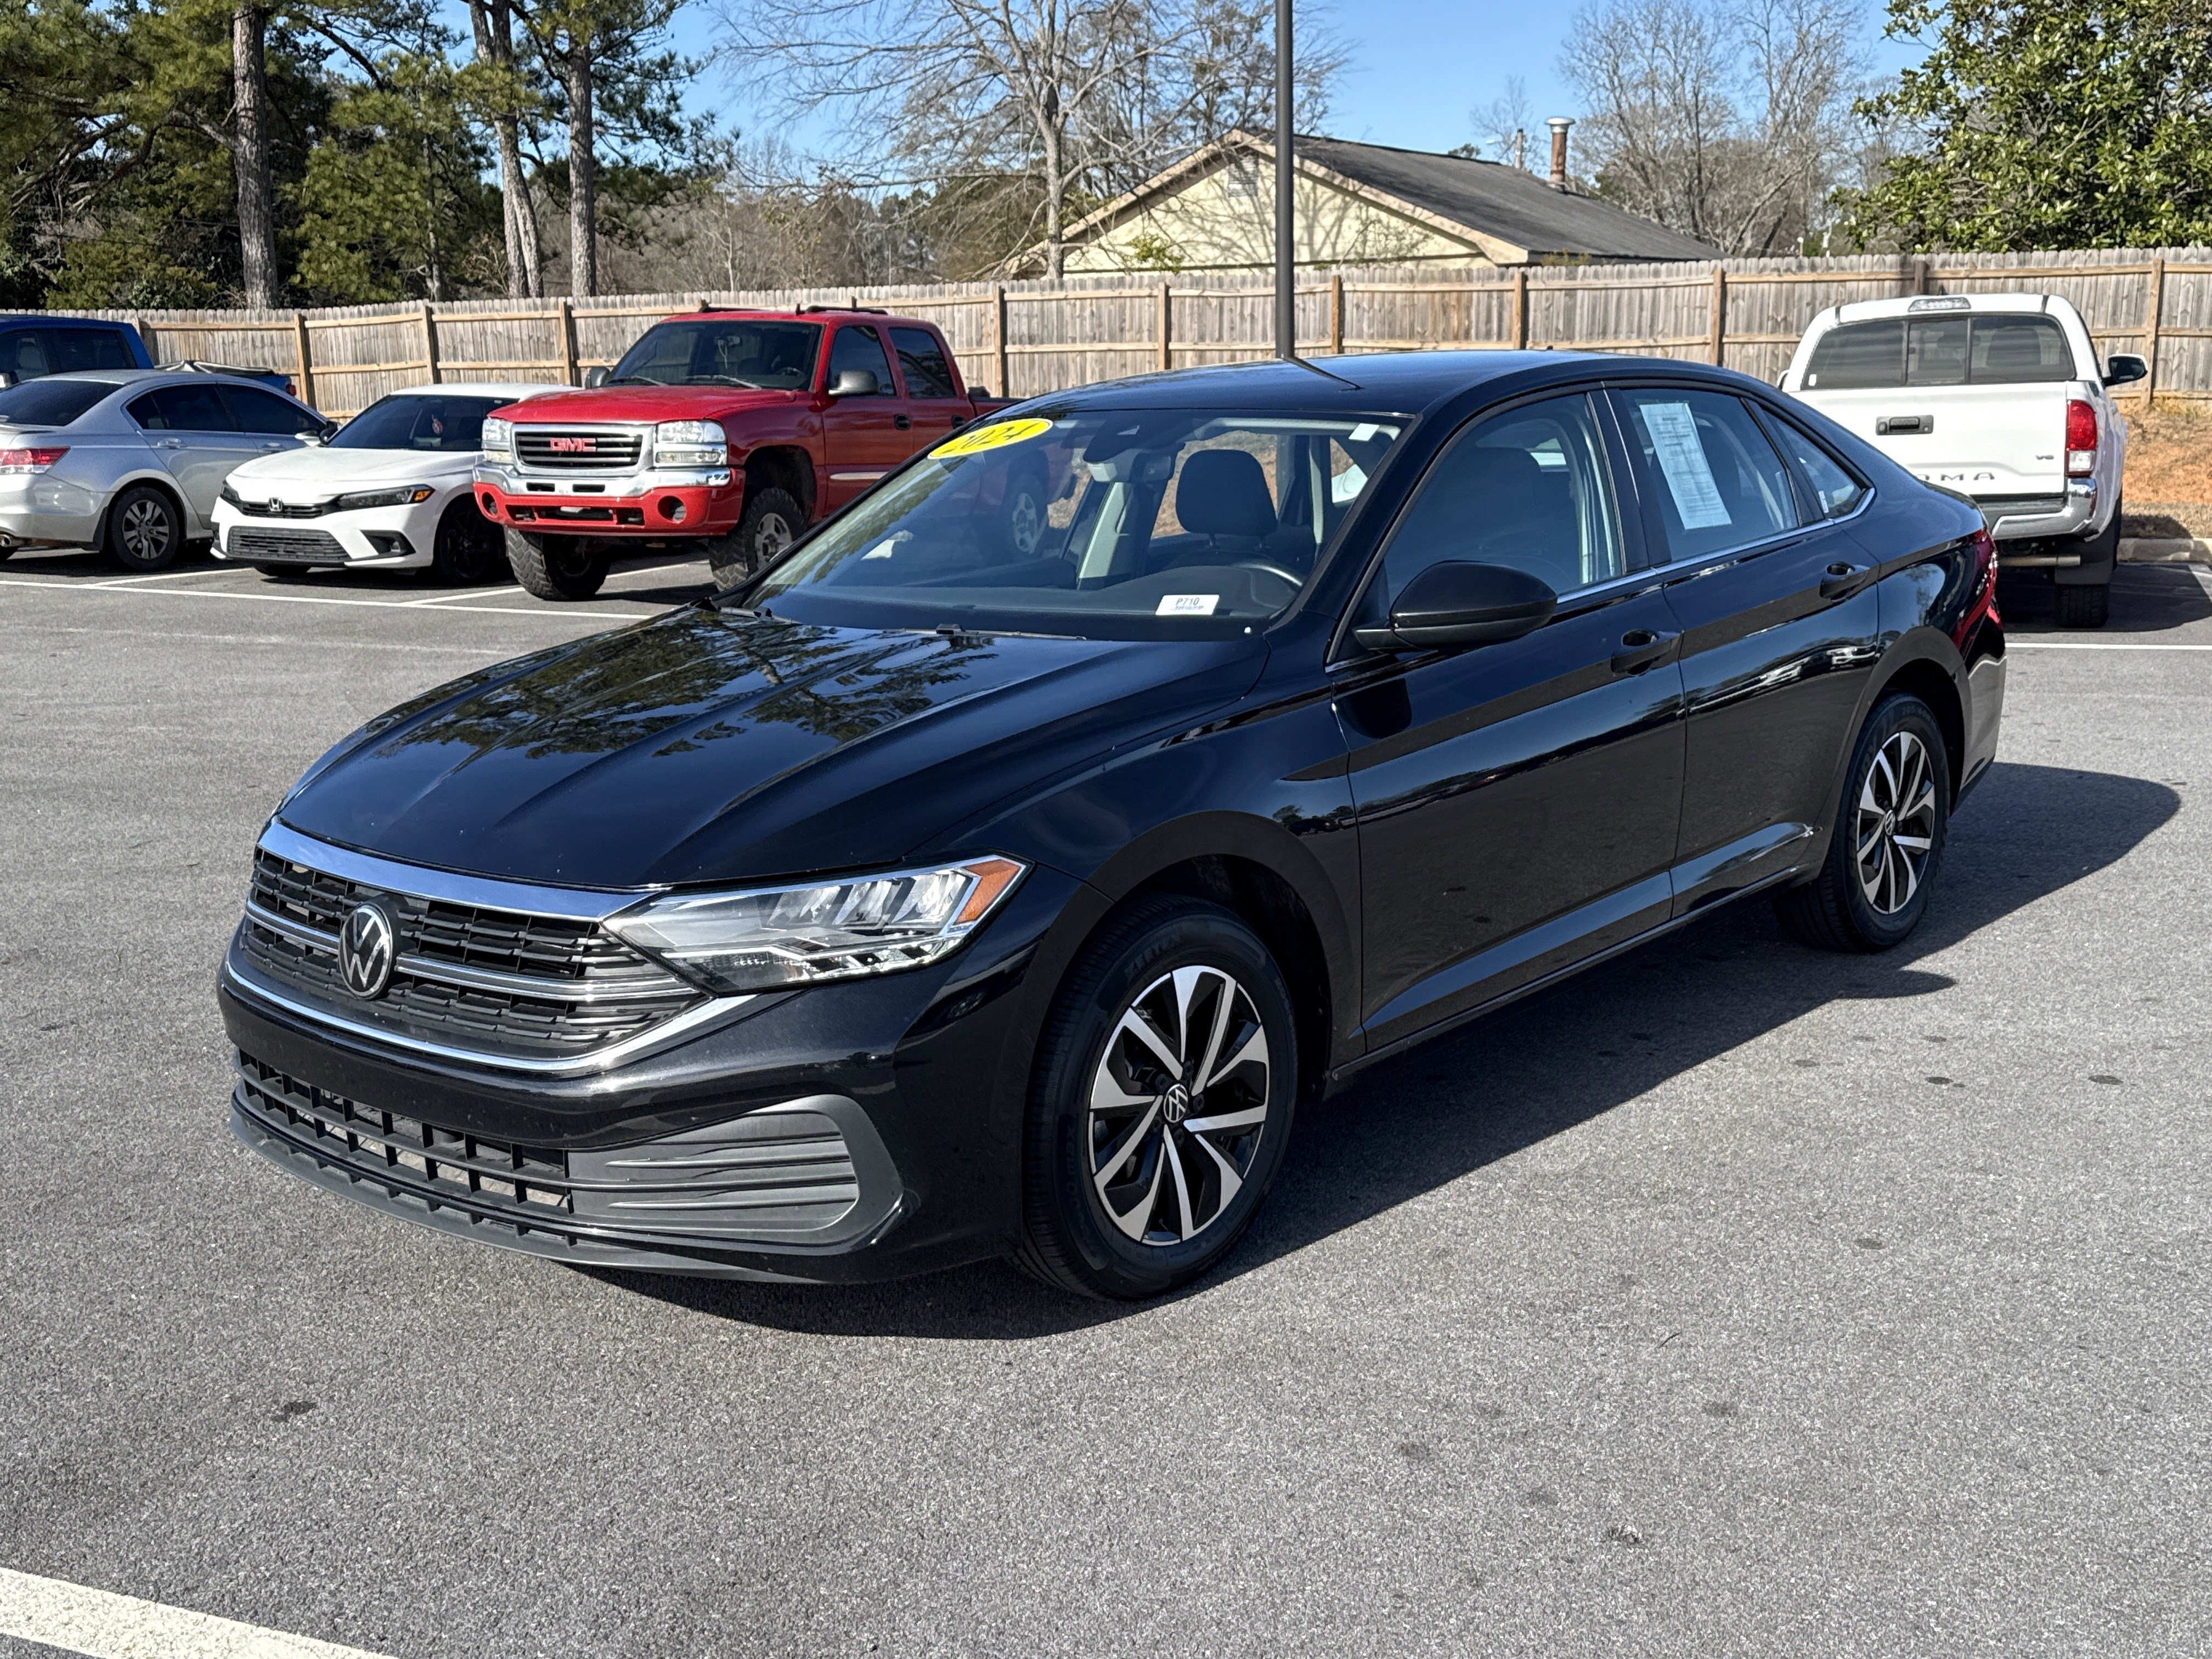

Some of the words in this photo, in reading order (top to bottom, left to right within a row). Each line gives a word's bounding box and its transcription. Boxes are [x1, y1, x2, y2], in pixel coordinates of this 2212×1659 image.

[550, 437, 596, 452] GMC
[939, 422, 1041, 455] 2024
[1175, 597, 1200, 606] P710
